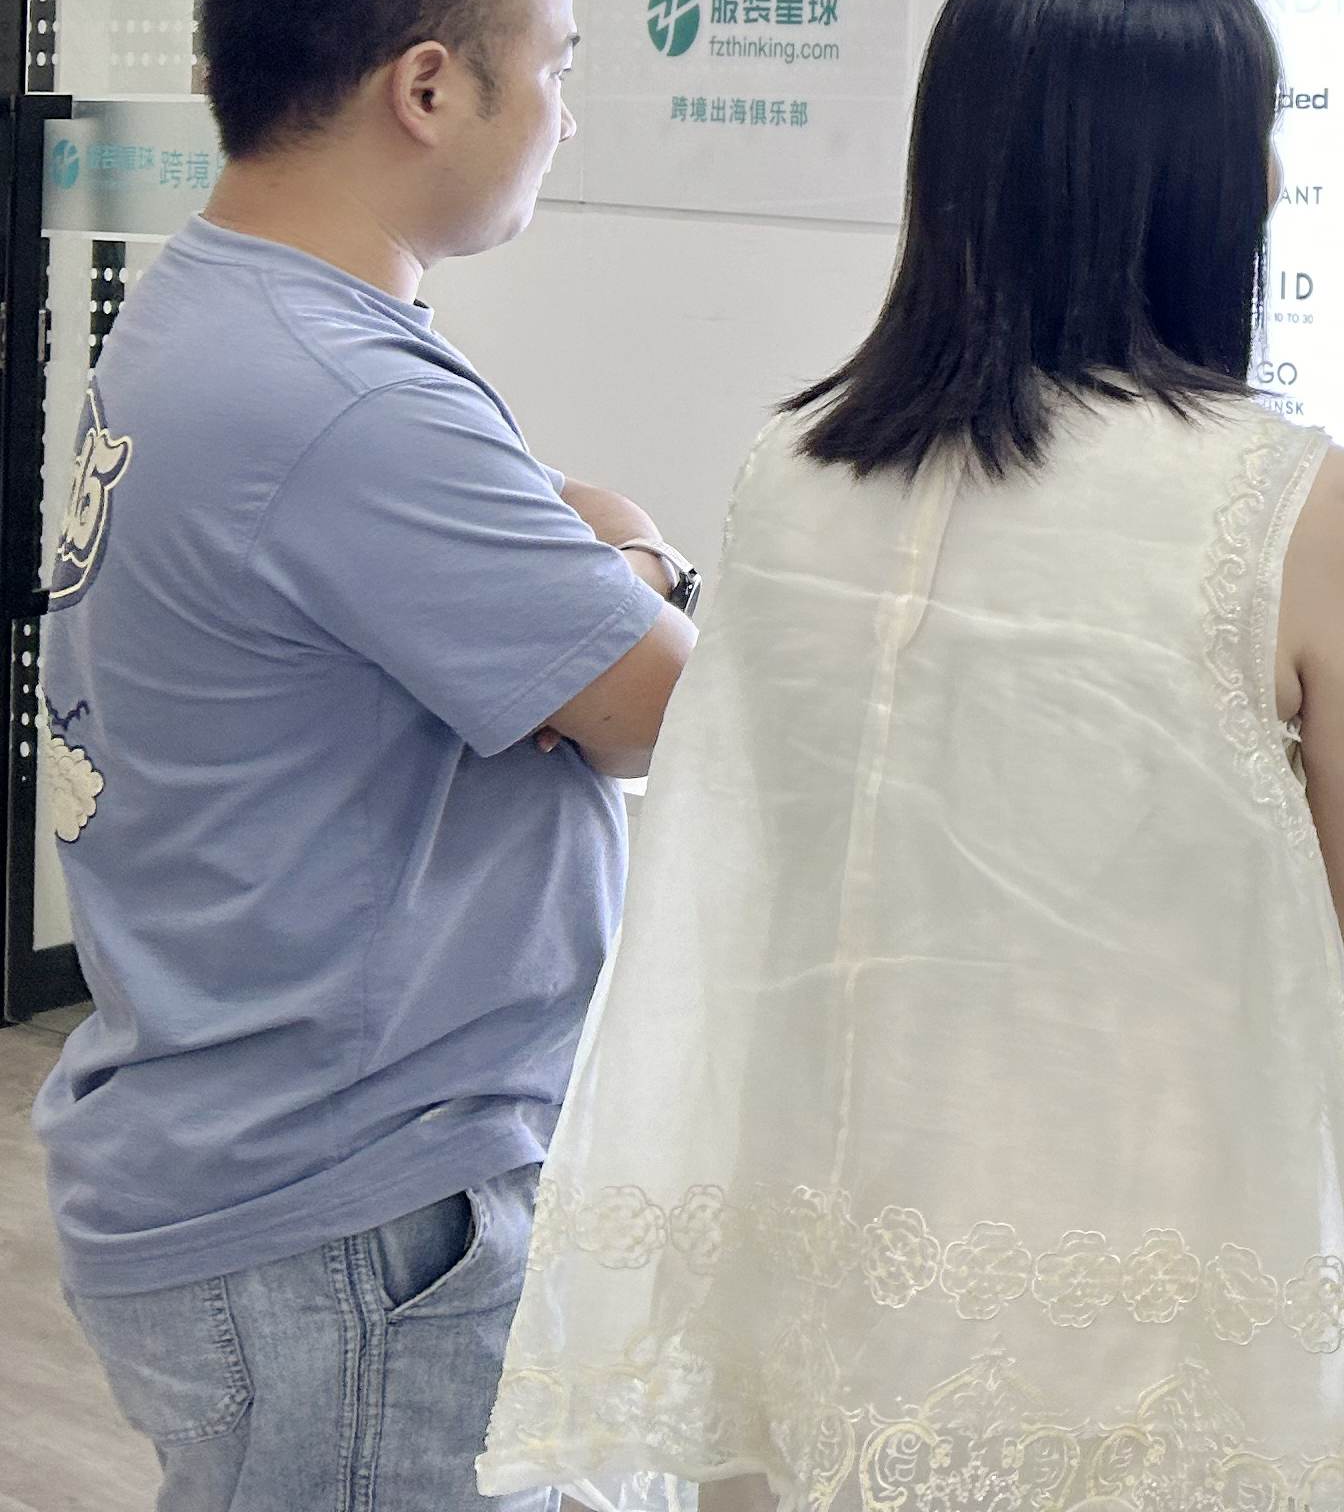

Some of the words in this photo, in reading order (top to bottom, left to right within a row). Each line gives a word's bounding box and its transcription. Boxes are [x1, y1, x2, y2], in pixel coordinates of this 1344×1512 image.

[708, 35, 840, 64] fzthinking.com
[1279, 87, 1329, 110] ded
[670, 95, 808, 128] 跨境出海俱乐部
[1281, 185, 1323, 205] ANT
[1280, 271, 1314, 300] ID
[1287, 312, 1299, 324] TO
[1302, 313, 1314, 324] 30
[1257, 360, 1298, 385] GO
